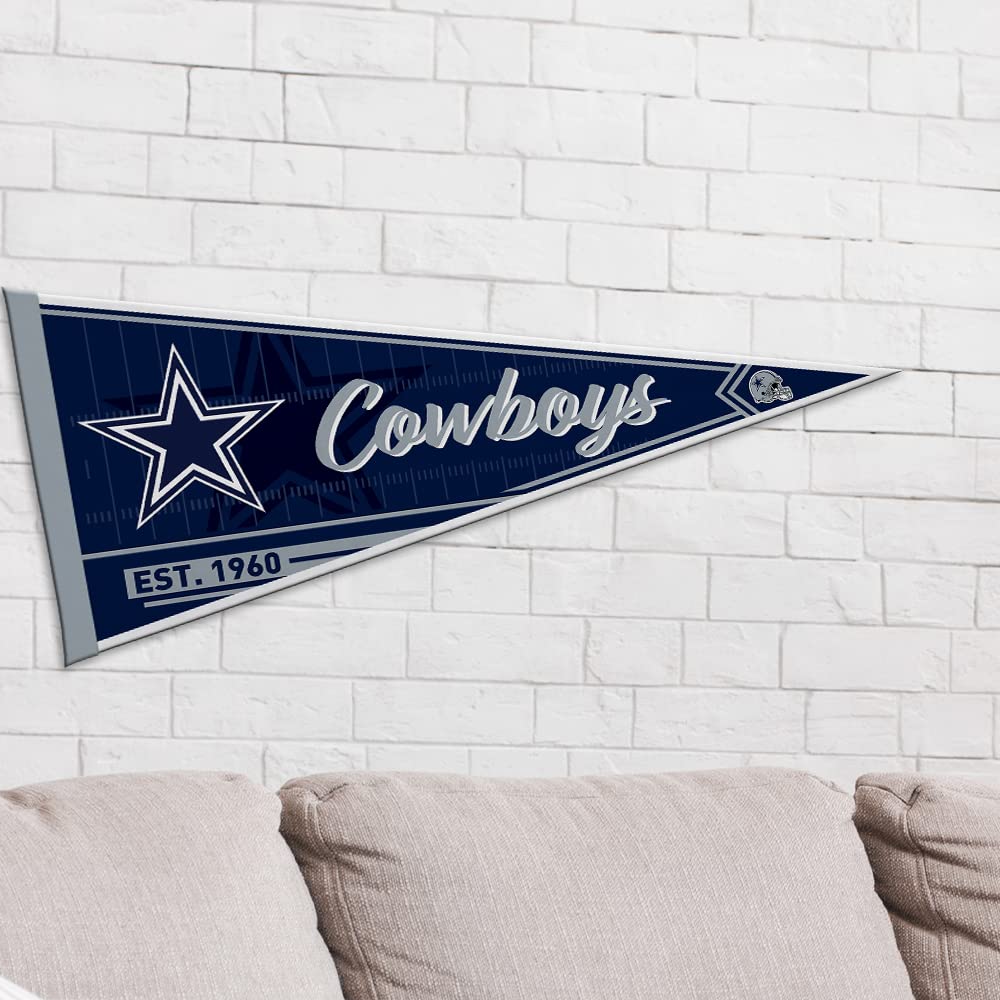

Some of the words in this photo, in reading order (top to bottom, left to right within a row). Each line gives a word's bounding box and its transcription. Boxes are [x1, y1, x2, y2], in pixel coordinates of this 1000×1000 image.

[315, 367, 672, 473] Cowboys
[133, 564, 203, 594] EST.
[211, 552, 281, 582] 1960
